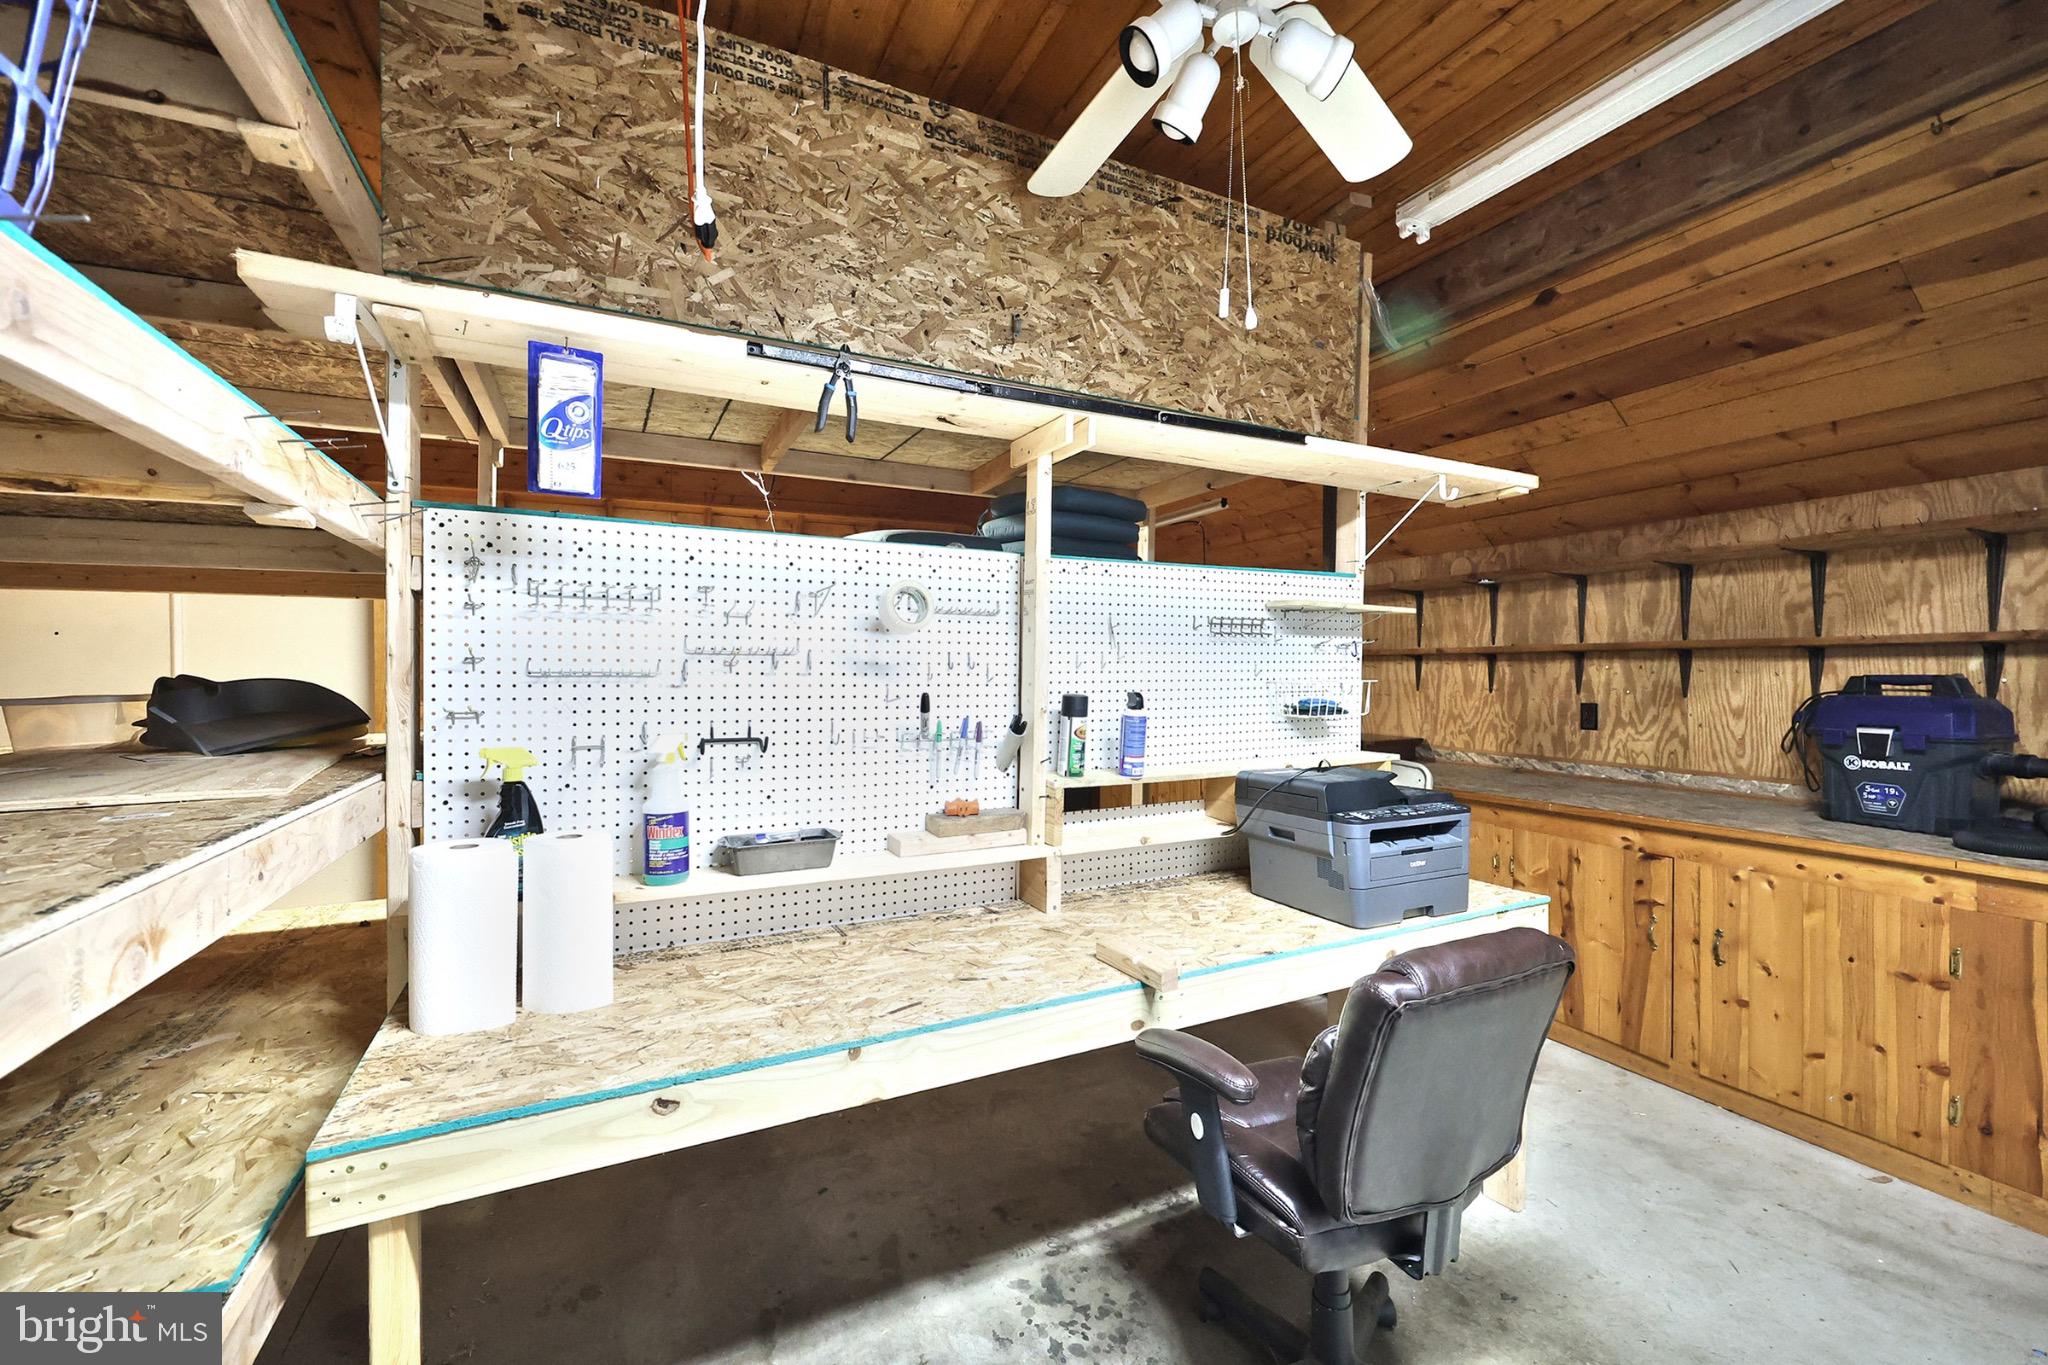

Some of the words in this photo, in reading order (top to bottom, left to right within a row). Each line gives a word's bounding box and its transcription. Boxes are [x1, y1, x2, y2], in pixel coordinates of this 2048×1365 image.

[603, 28, 635, 47] ALL
[714, 34, 754, 55] CLIPS
[635, 38, 683, 62] SPACE
[755, 47, 793, 67] ROOF
[743, 72, 777, 91] SIDE
[776, 82, 807, 100] THIS
[1861, 759, 1911, 771] KOBALT
[646, 824, 685, 841] Windex
